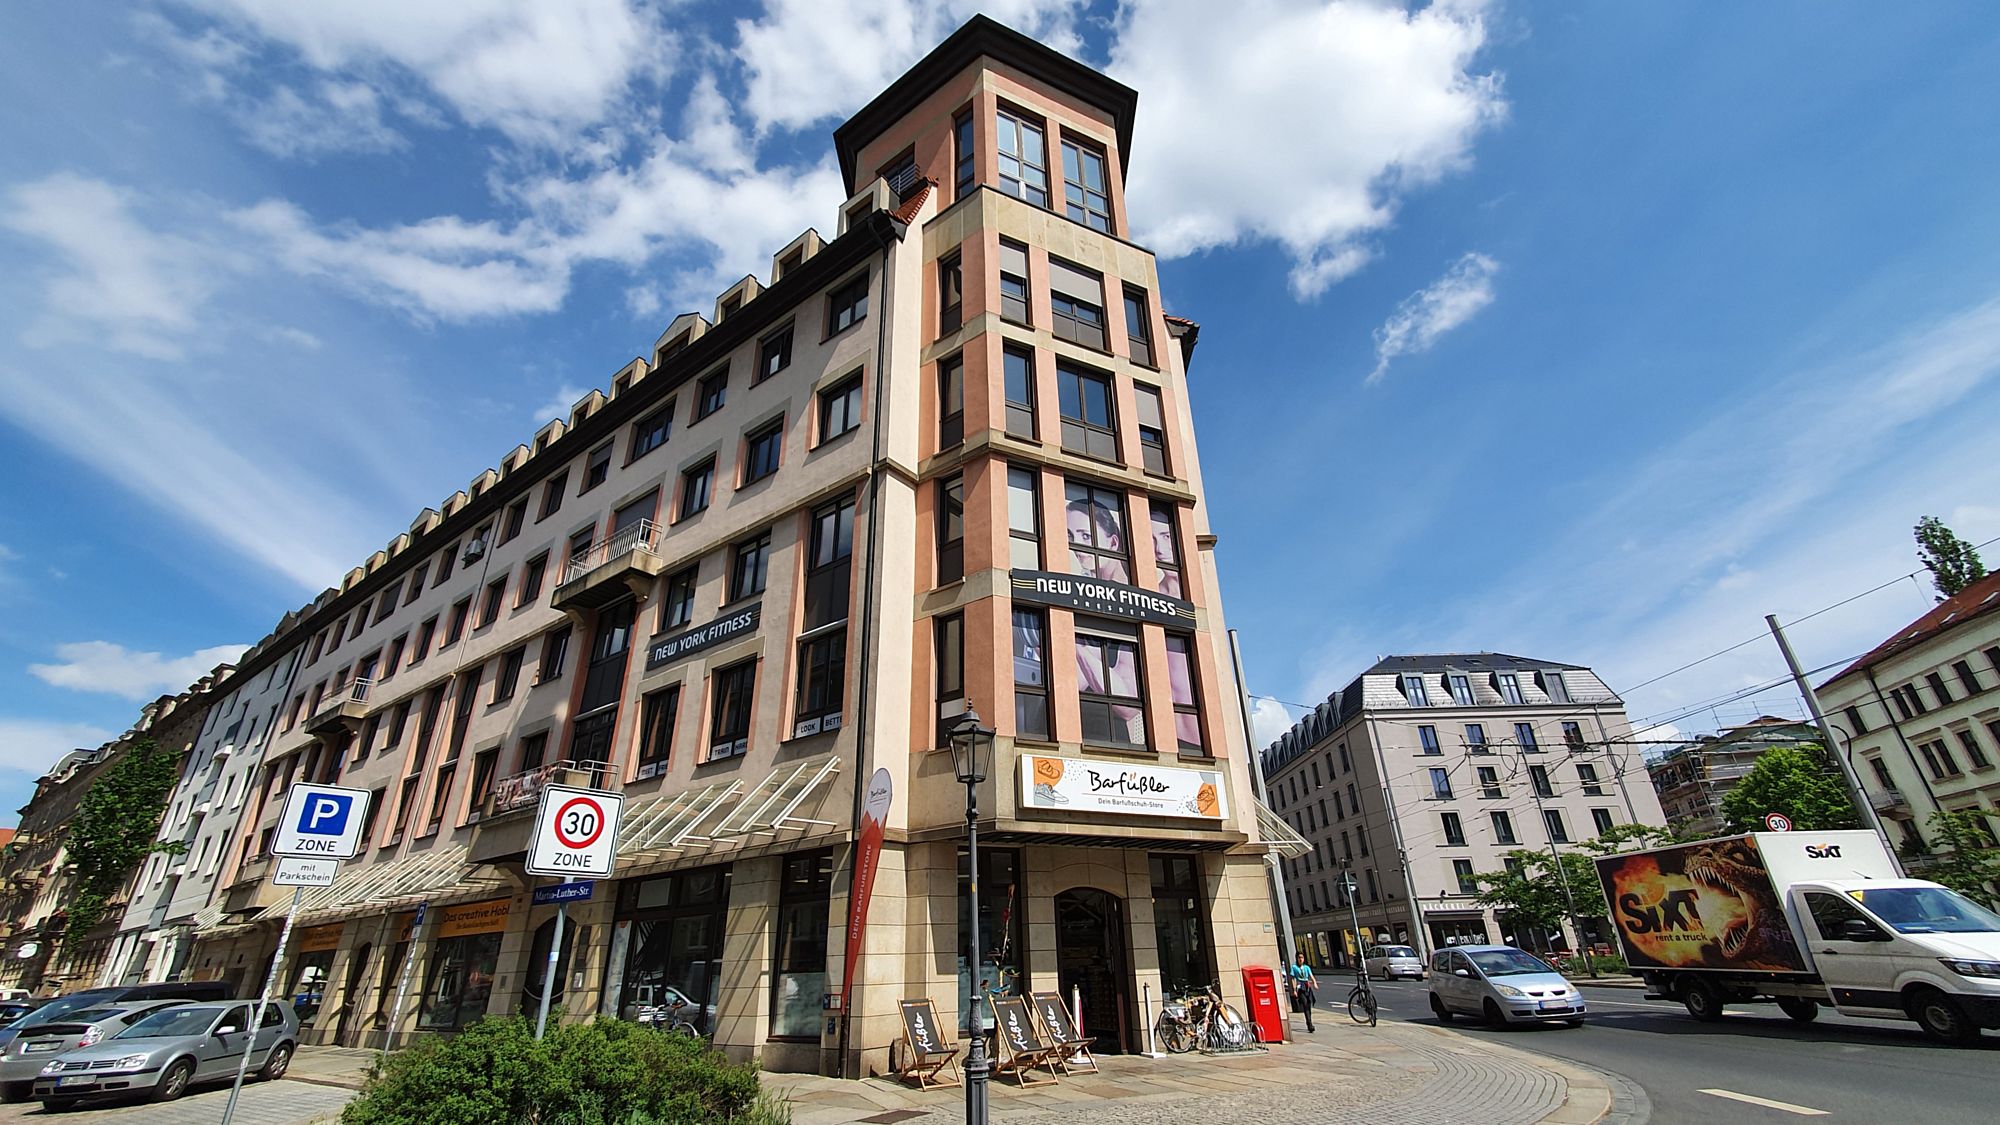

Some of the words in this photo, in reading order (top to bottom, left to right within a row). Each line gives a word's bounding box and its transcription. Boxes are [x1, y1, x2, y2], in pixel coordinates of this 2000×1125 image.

[1037, 578, 1071, 594] NEW
[1075, 582, 1116, 602] YORK
[1119, 590, 1177, 616] FITNESS
[655, 641, 678, 661] NEW
[679, 630, 707, 652] YORK
[708, 611, 752, 640] FITNESS
[800, 723, 816, 733] LOOK
[1087, 769, 1170, 794] Barfüßler
[1098, 797, 1111, 805] Dein
[309, 799, 340, 829] P
[564, 811, 595, 837] 30
[1770, 816, 1787, 830] 30
[295, 839, 337, 852] ZONE
[553, 852, 592, 868] ZONE
[300, 864, 316, 872] mit
[279, 872, 330, 881] Parkschein
[416, 906, 425, 923] P
[457, 908, 489, 920] creative
[852, 916, 860, 939] DEIN
[1655, 933, 1673, 942] rent
[1683, 932, 1708, 942] truck
